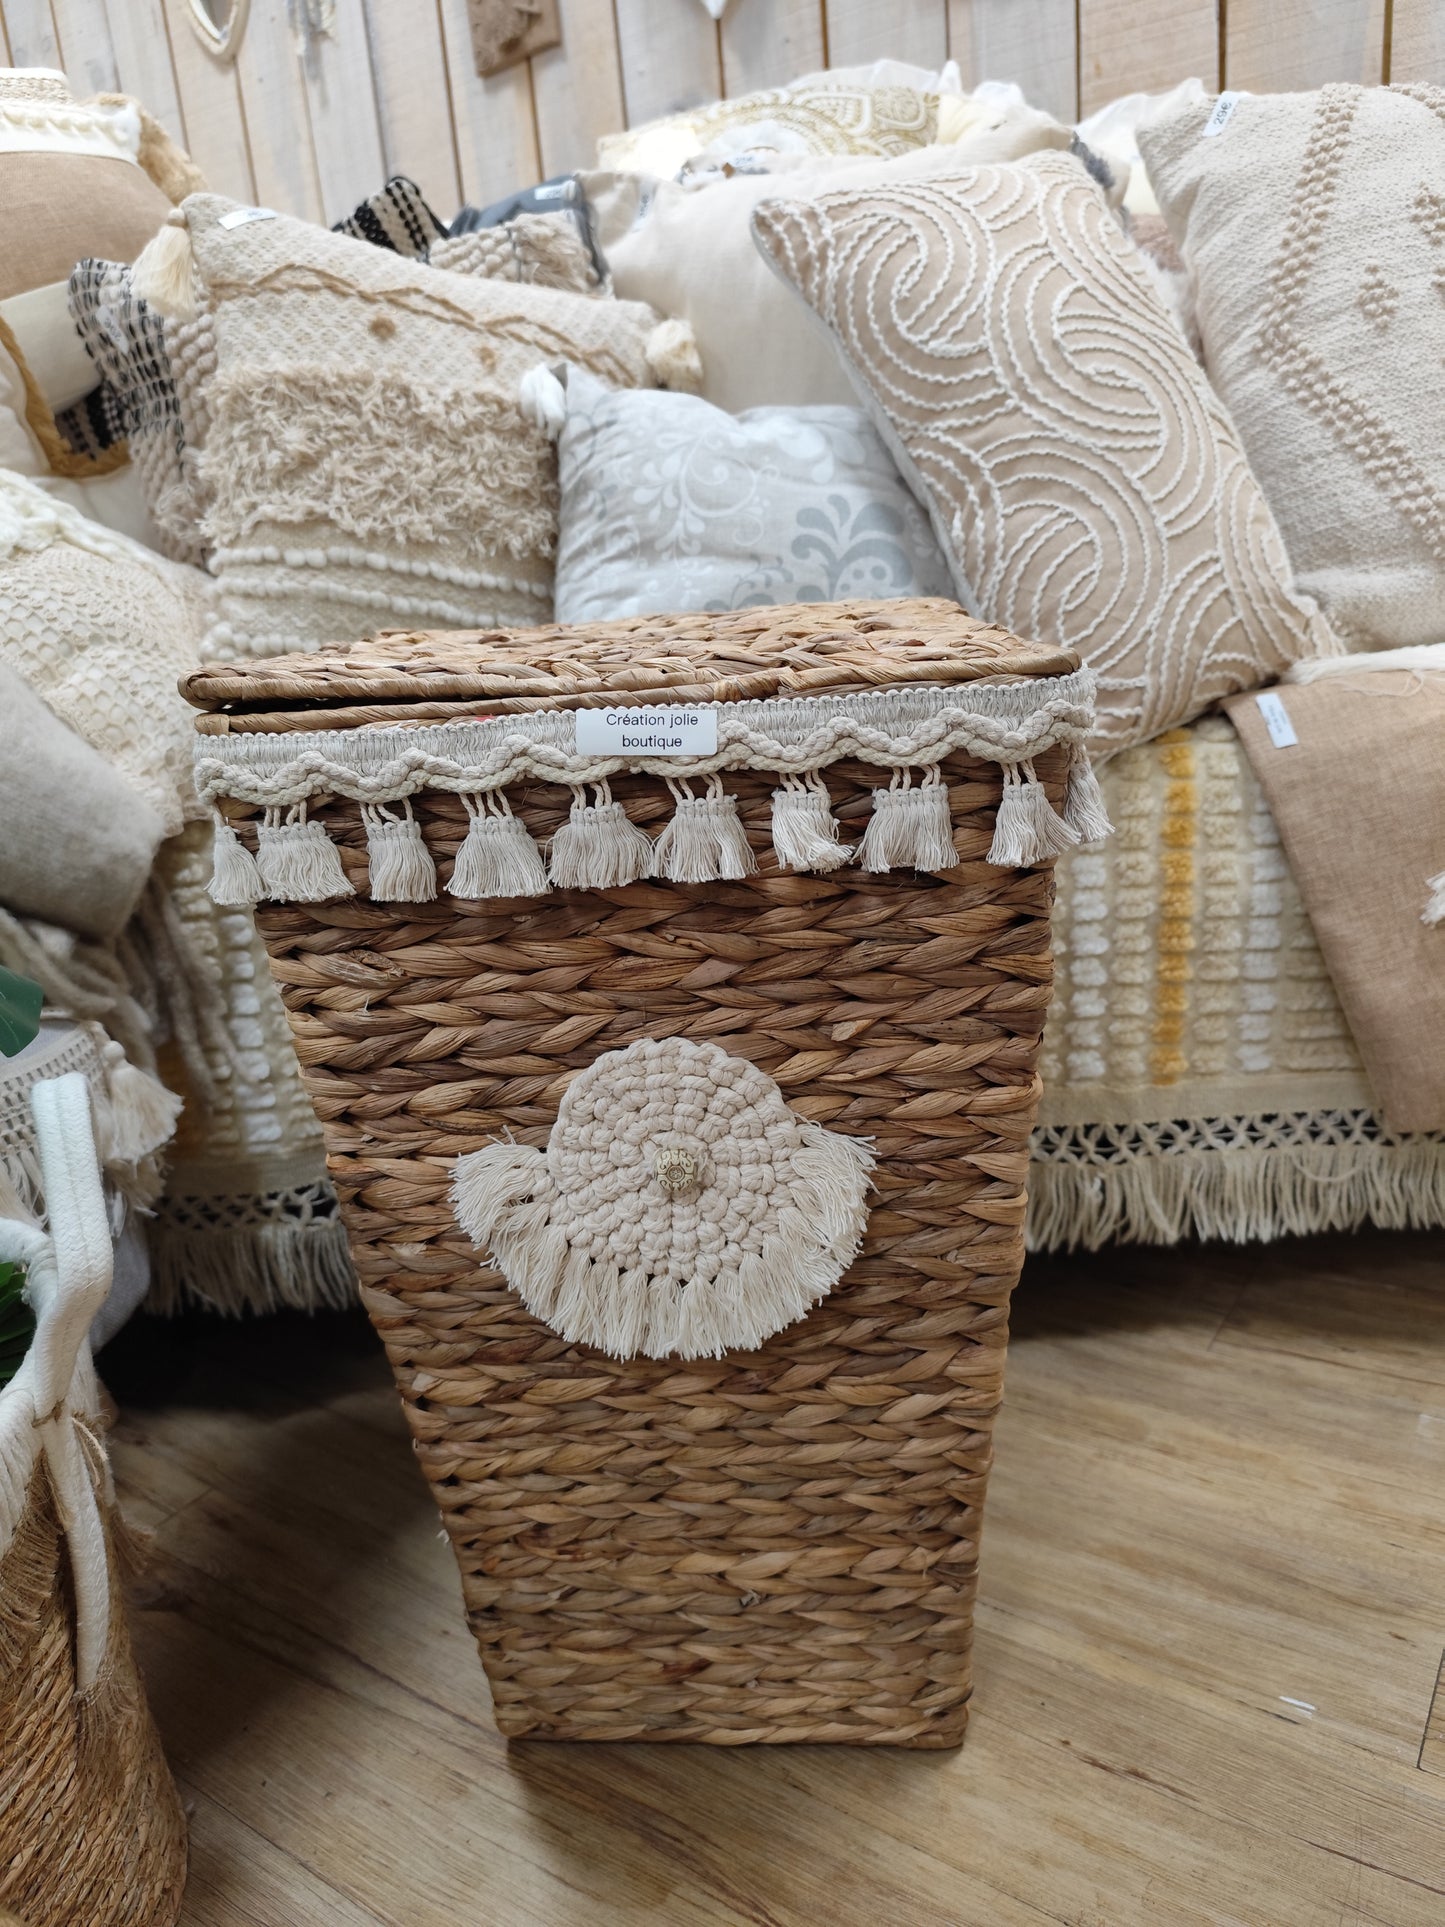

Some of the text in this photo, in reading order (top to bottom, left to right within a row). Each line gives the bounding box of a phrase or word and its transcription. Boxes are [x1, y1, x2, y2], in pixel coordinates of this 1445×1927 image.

[1213, 102, 1231, 124] 29€
[606, 713, 698, 728] Création jolie
[622, 735, 682, 749] boutique
